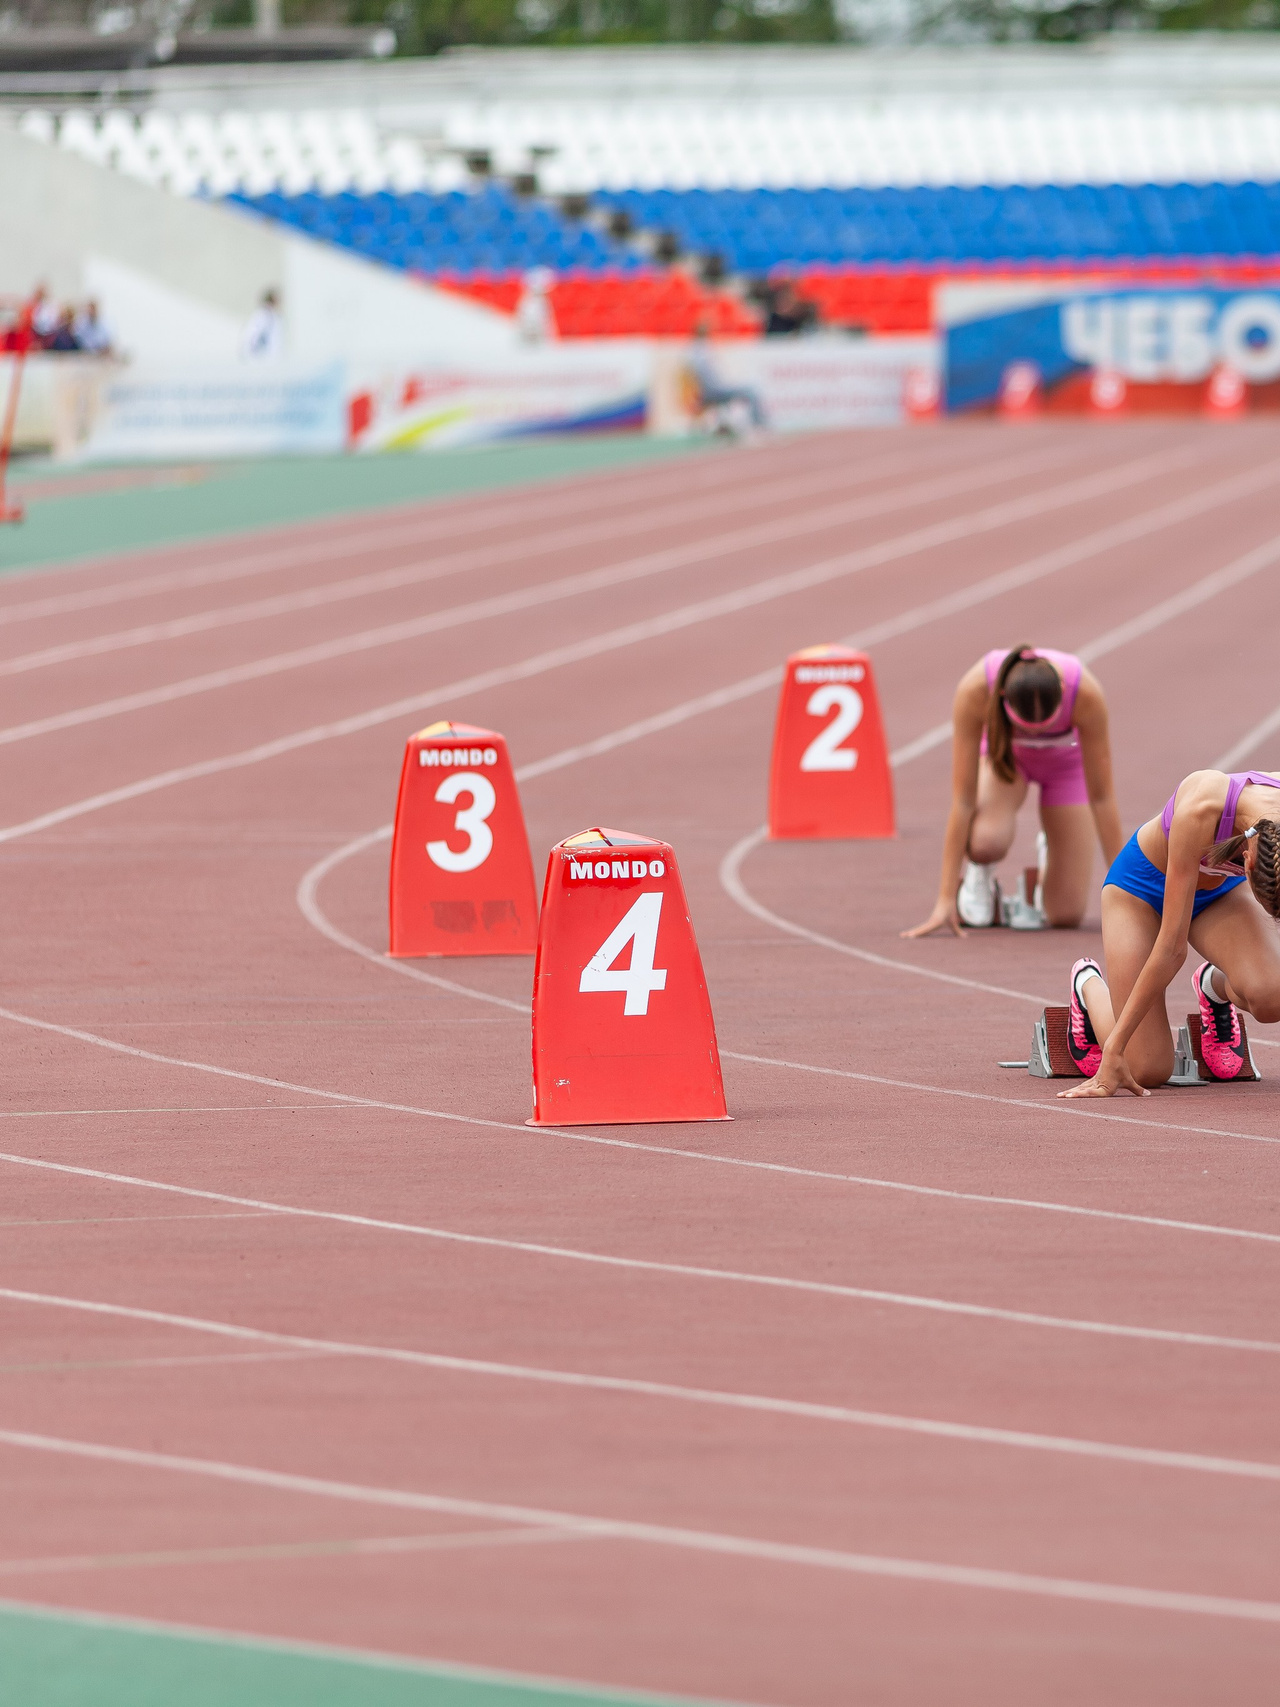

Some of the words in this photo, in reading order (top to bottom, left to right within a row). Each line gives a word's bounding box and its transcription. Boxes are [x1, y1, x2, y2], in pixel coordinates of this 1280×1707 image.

[420, 748, 498, 767] MONDO
[799, 682, 864, 772] 2
[426, 770, 496, 873] 3
[570, 860, 665, 880] MONDO
[578, 891, 668, 1016] 4
